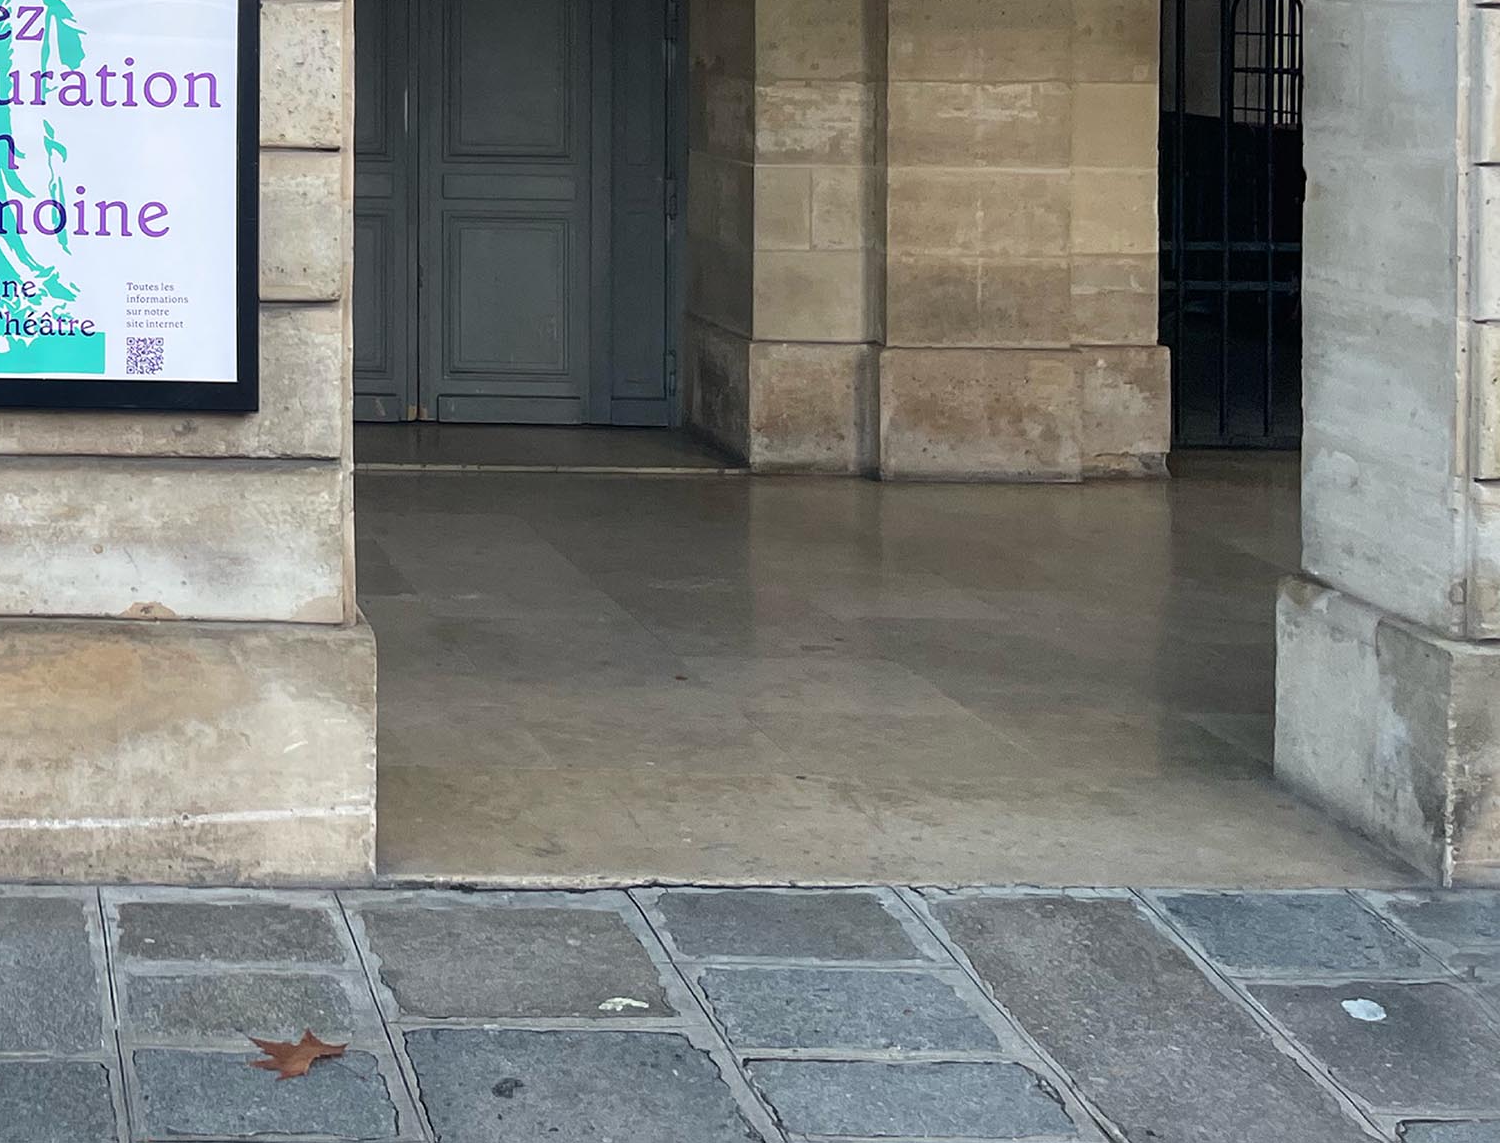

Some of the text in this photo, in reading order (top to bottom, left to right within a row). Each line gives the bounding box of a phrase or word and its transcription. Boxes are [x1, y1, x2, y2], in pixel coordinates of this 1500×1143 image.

[126, 281, 175, 292] Toutes les
[126, 293, 189, 304] informations
[126, 308, 170, 317] sur notre
[126, 319, 184, 329] site internet
